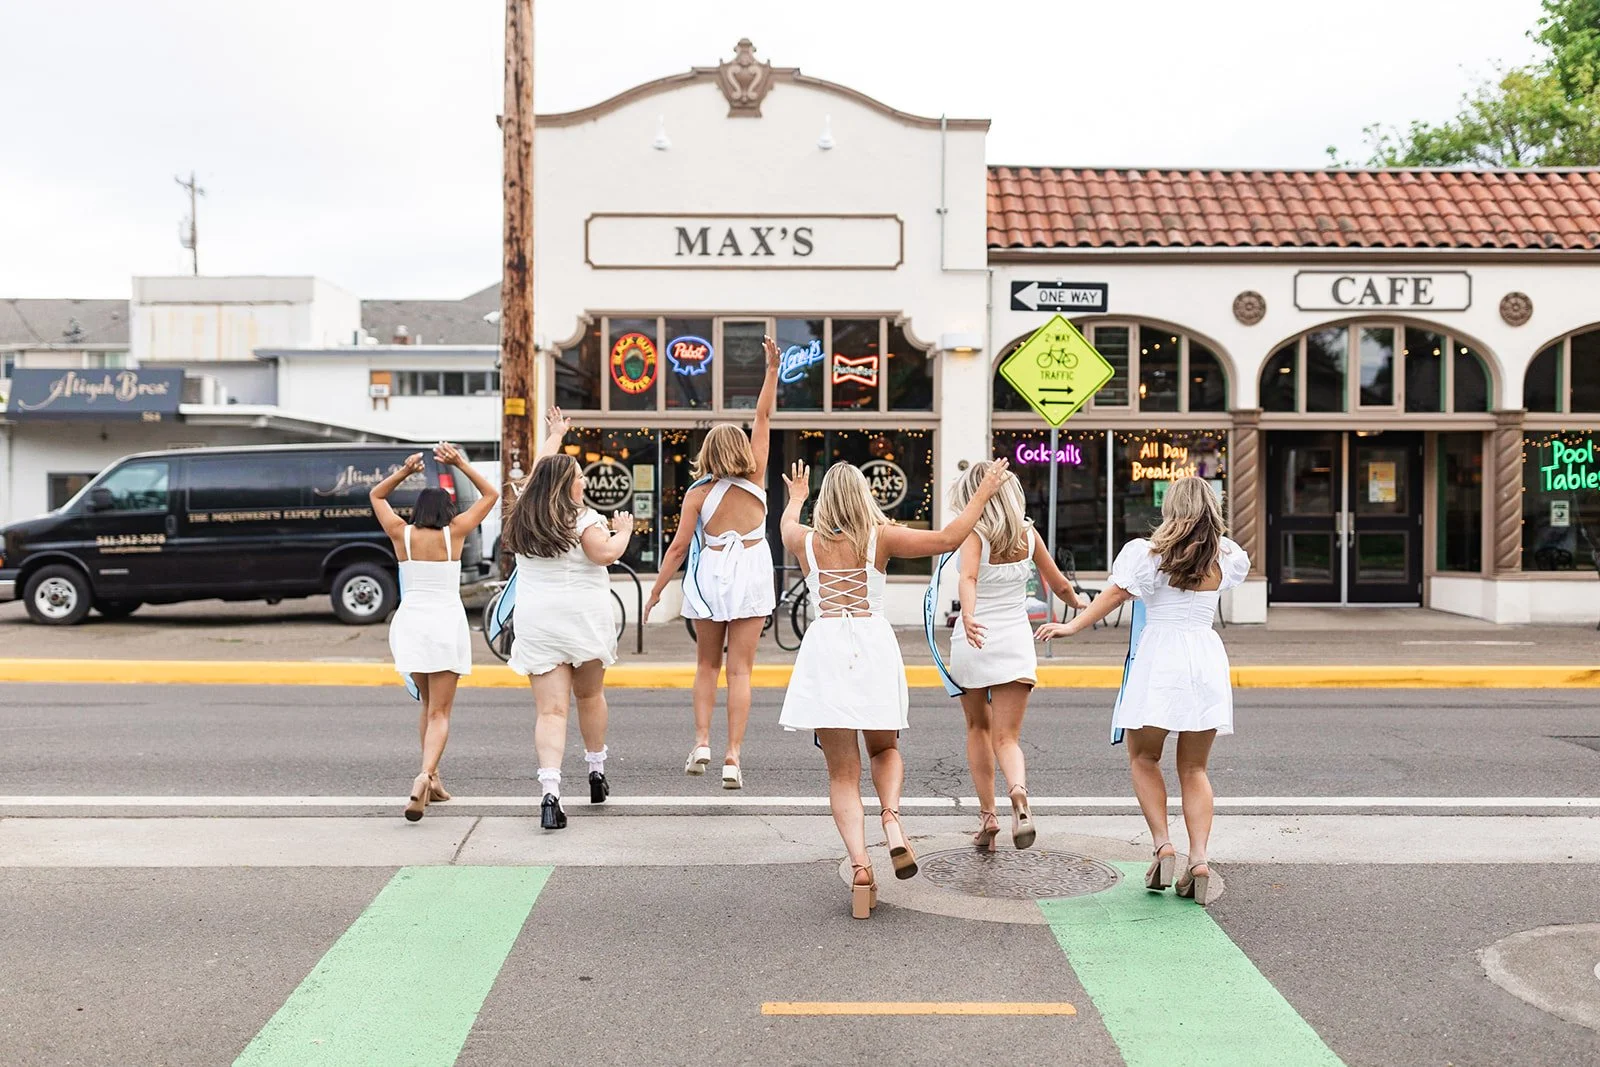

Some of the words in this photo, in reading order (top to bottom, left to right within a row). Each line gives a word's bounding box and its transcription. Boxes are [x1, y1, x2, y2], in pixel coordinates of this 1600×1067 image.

[675, 227, 814, 257] MAX'S
[1039, 290, 1065, 303] ONE
[1071, 291, 1098, 303] WAY
[1331, 276, 1434, 305] CAFE
[674, 342, 708, 360] Pabst
[833, 364, 879, 377] Budweiser
[1040, 370, 1074, 380] TRAFFIC
[1016, 443, 1082, 465] Cockails
[1139, 442, 1159, 460] All
[1163, 443, 1188, 465] Day
[1551, 440, 1594, 467] Pool
[1131, 461, 1197, 483] Breakfast
[1541, 463, 1600, 491] Table
[583, 475, 630, 490] MAX'S
[589, 490, 625, 498] Tavern
[188, 513, 209, 523] THE
[283, 509, 321, 520] EXPERT
[323, 508, 372, 519] CLEANING
